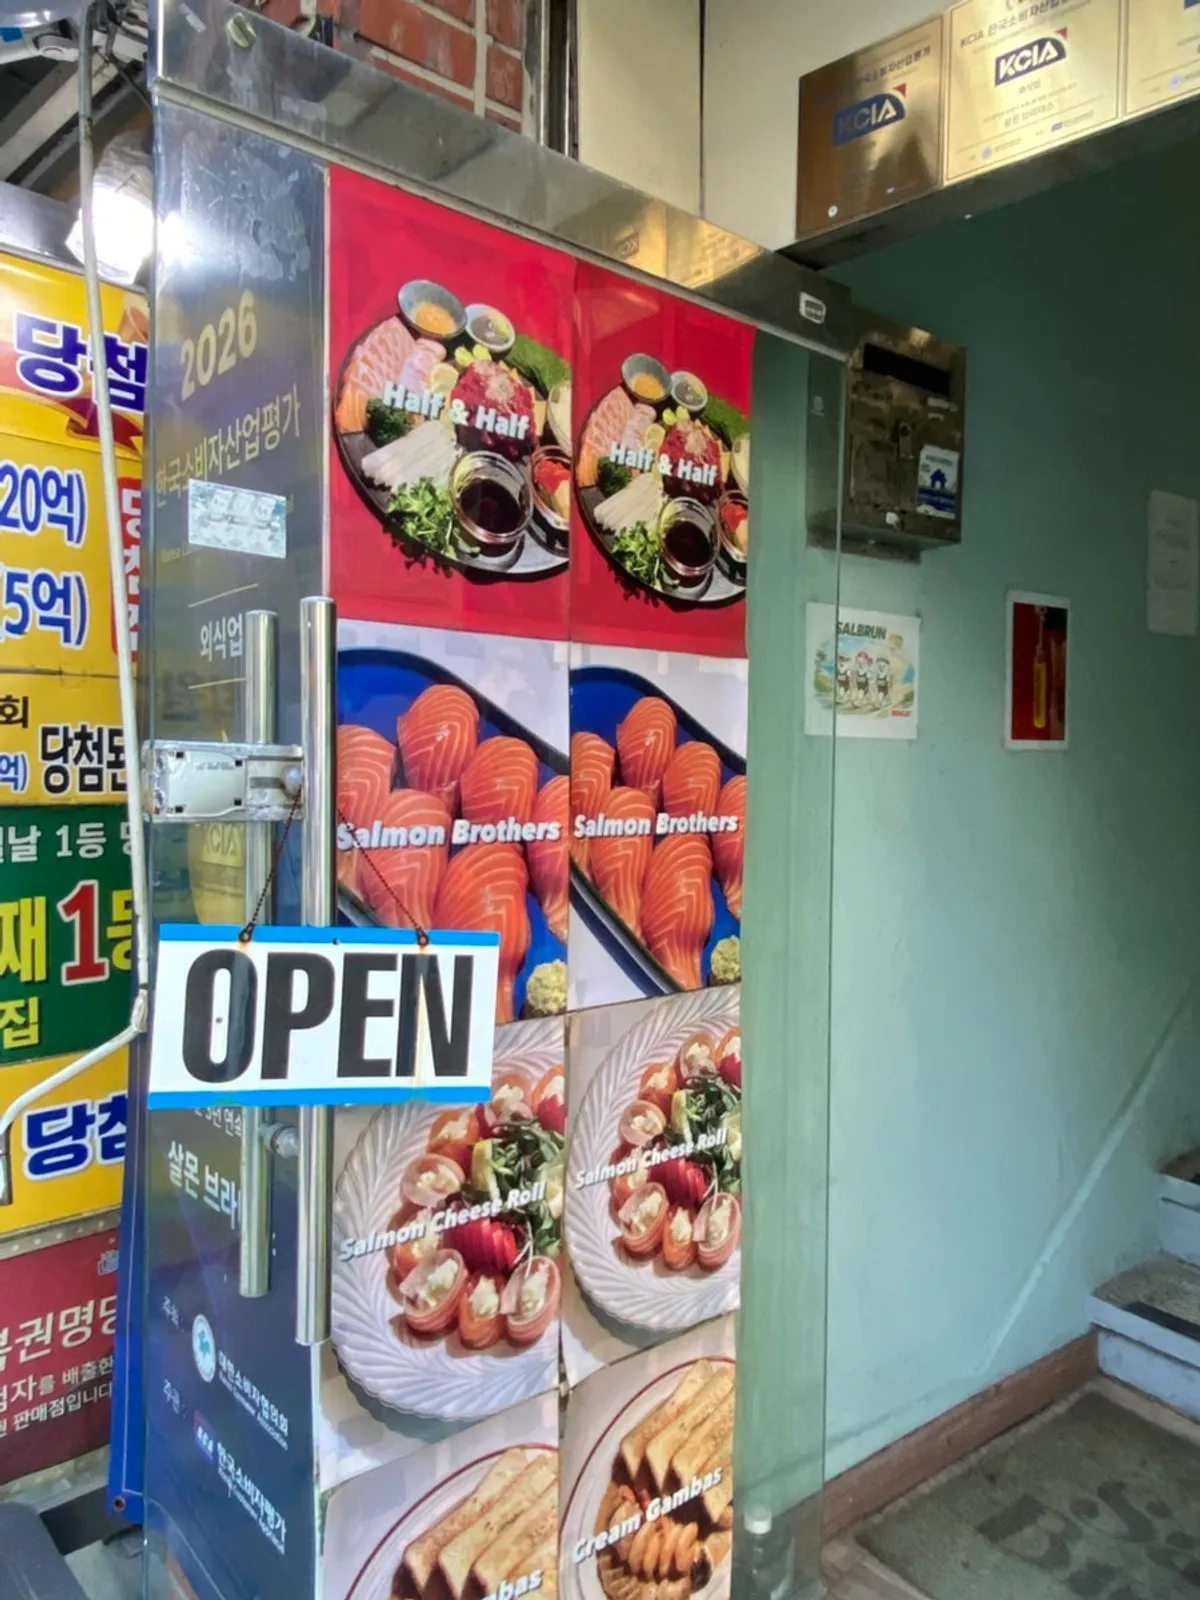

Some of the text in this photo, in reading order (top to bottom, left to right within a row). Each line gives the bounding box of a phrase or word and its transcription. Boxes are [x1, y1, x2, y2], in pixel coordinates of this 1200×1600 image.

[999, 41, 1058, 80] KCIA
[181, 289, 257, 401] 2026
[383, 382, 530, 441] Half & Half
[609, 441, 718, 487] Half & Half
[200, 613, 243, 662] 외식업
[0, 695, 29, 728] 회
[55, 823, 107, 859] 1등
[336, 817, 561, 850] Salmon Brothers
[574, 810, 738, 838] Salmon Brothers
[182, 948, 475, 1084] OPEN
[168, 1139, 242, 1230] 살몬 브라
[575, 1127, 728, 1191] Salmon Cheese Roll
[338, 1181, 548, 1264] Salmon Cheese Roll
[571, 1466, 723, 1564] Cream Gambas
